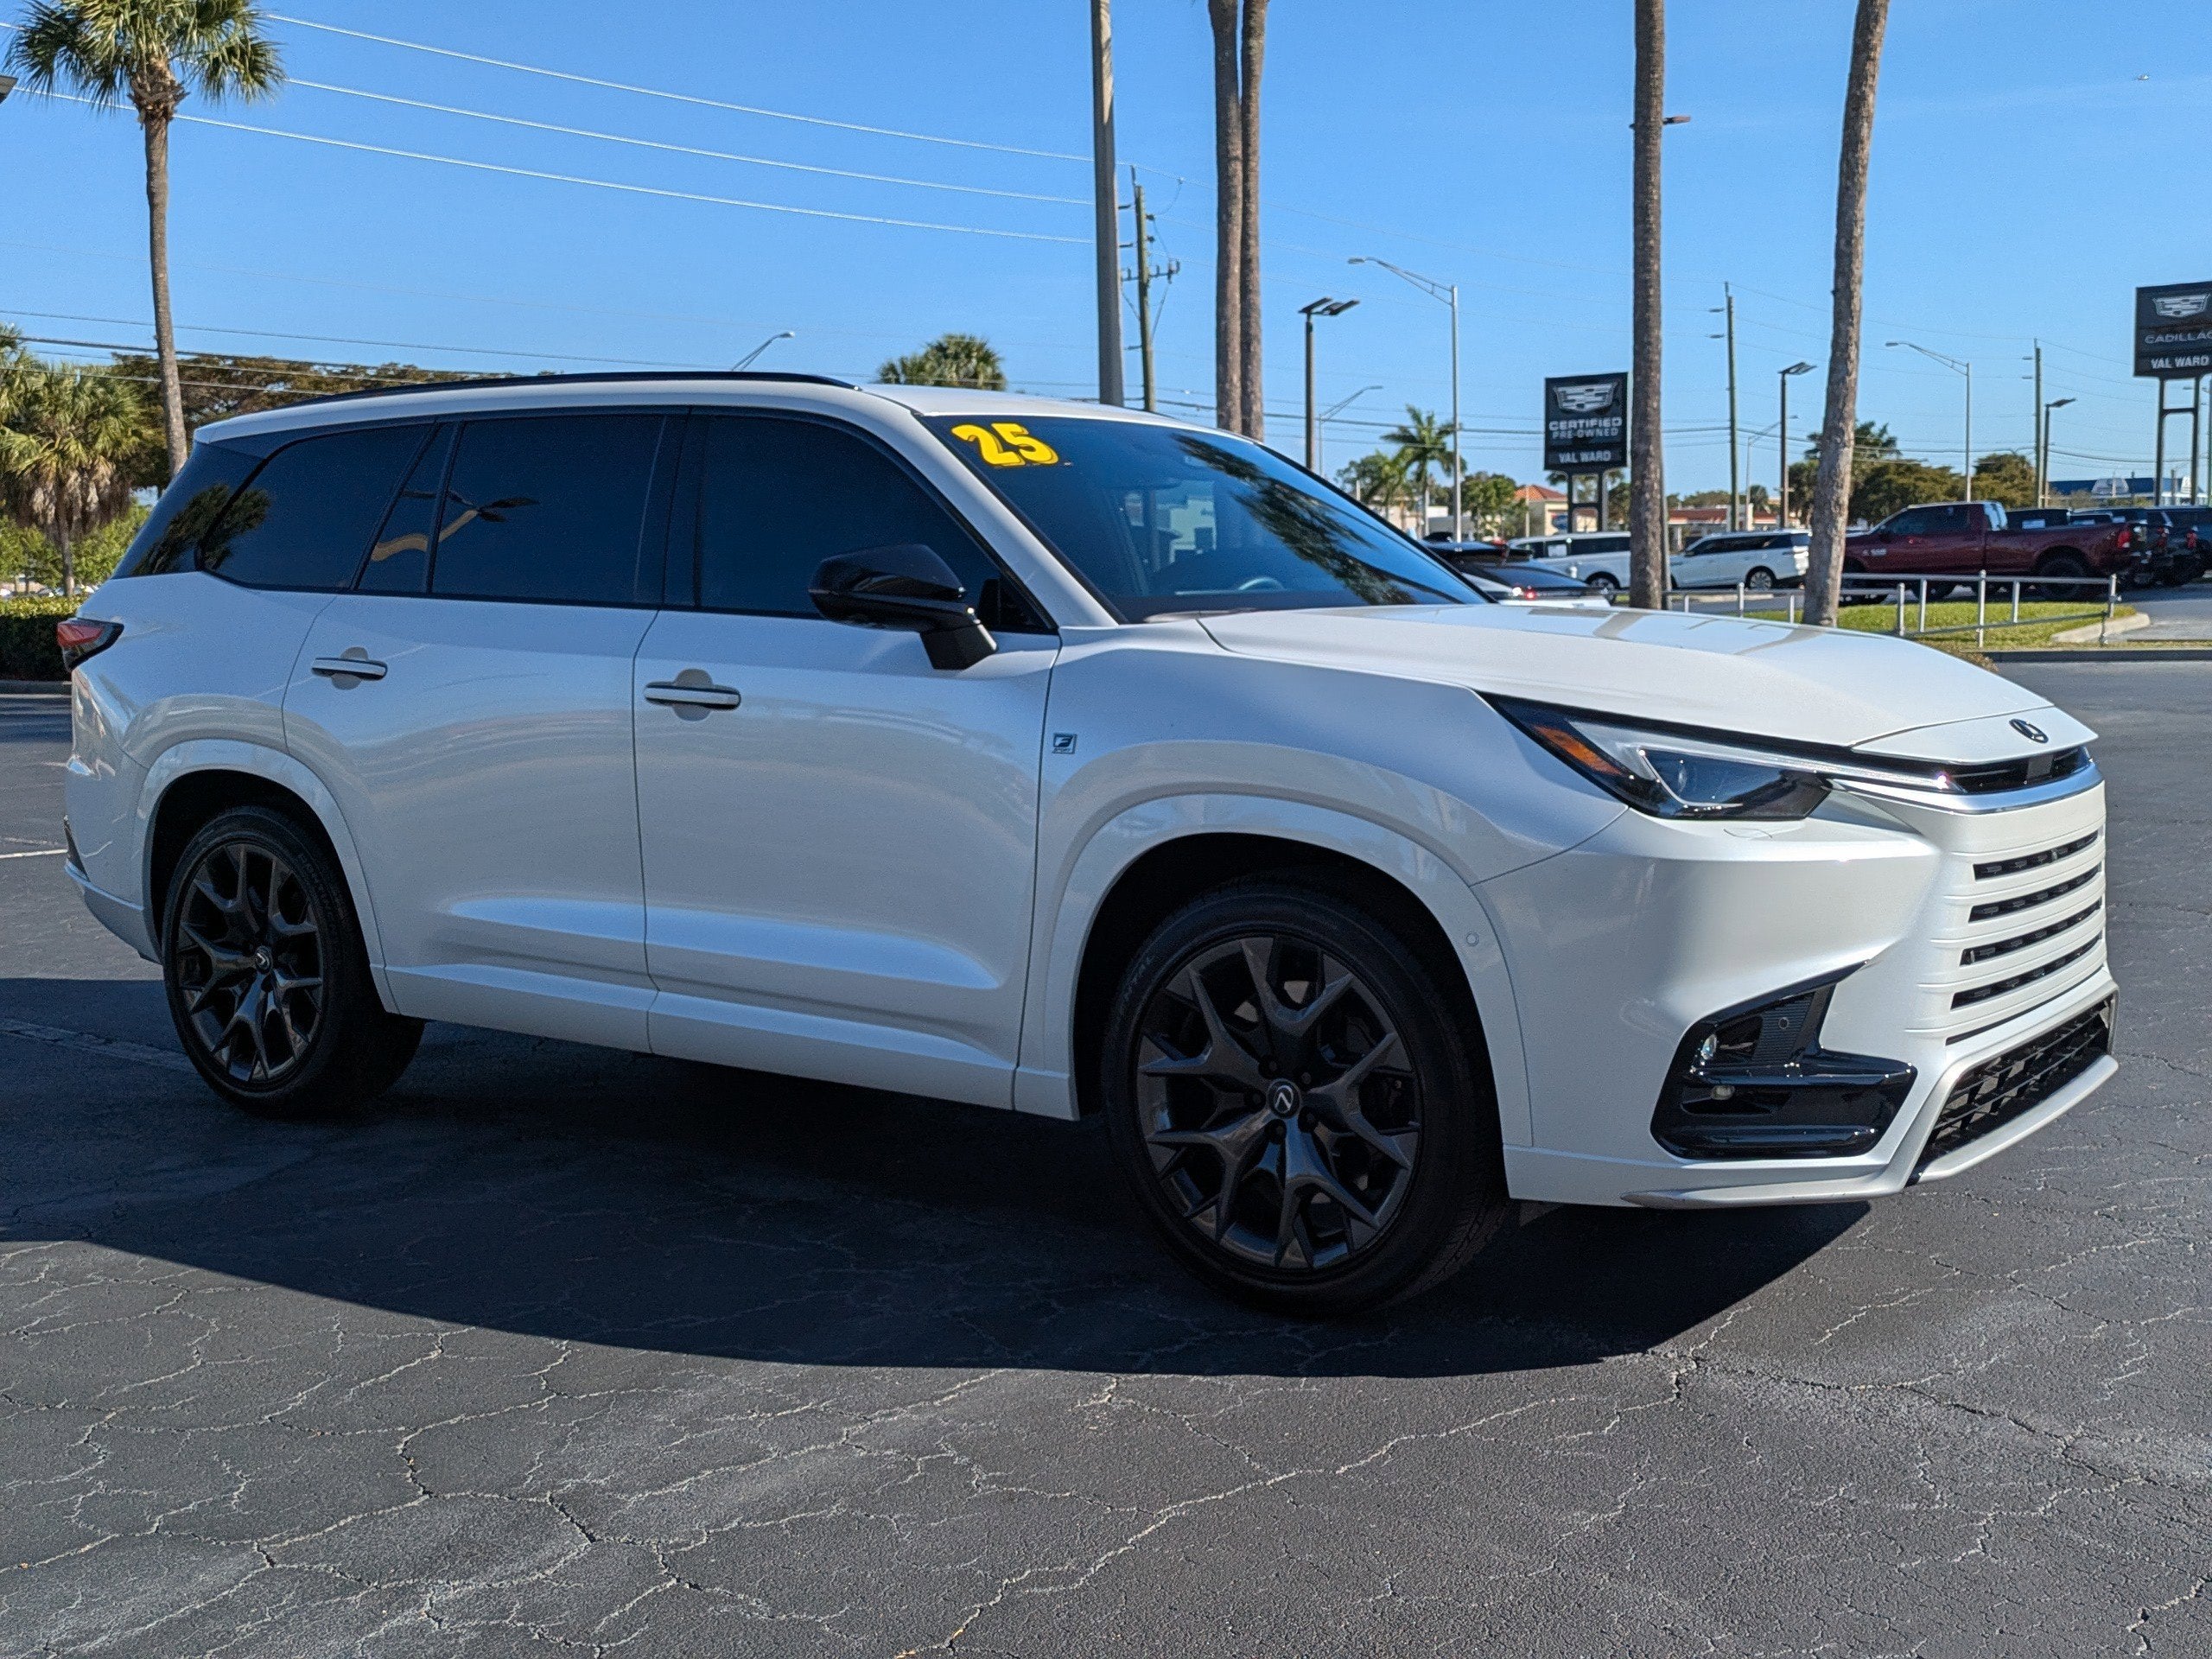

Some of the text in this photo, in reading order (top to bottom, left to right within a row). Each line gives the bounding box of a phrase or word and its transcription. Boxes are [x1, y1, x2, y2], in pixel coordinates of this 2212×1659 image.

[2151, 355, 2209, 369] VAL WARD
[1548, 416, 1623, 431] CERTIFIED
[1552, 427, 1619, 440] PRE-OWNED
[951, 423, 1059, 467] 25
[1559, 450, 1611, 463] VAL WARD
